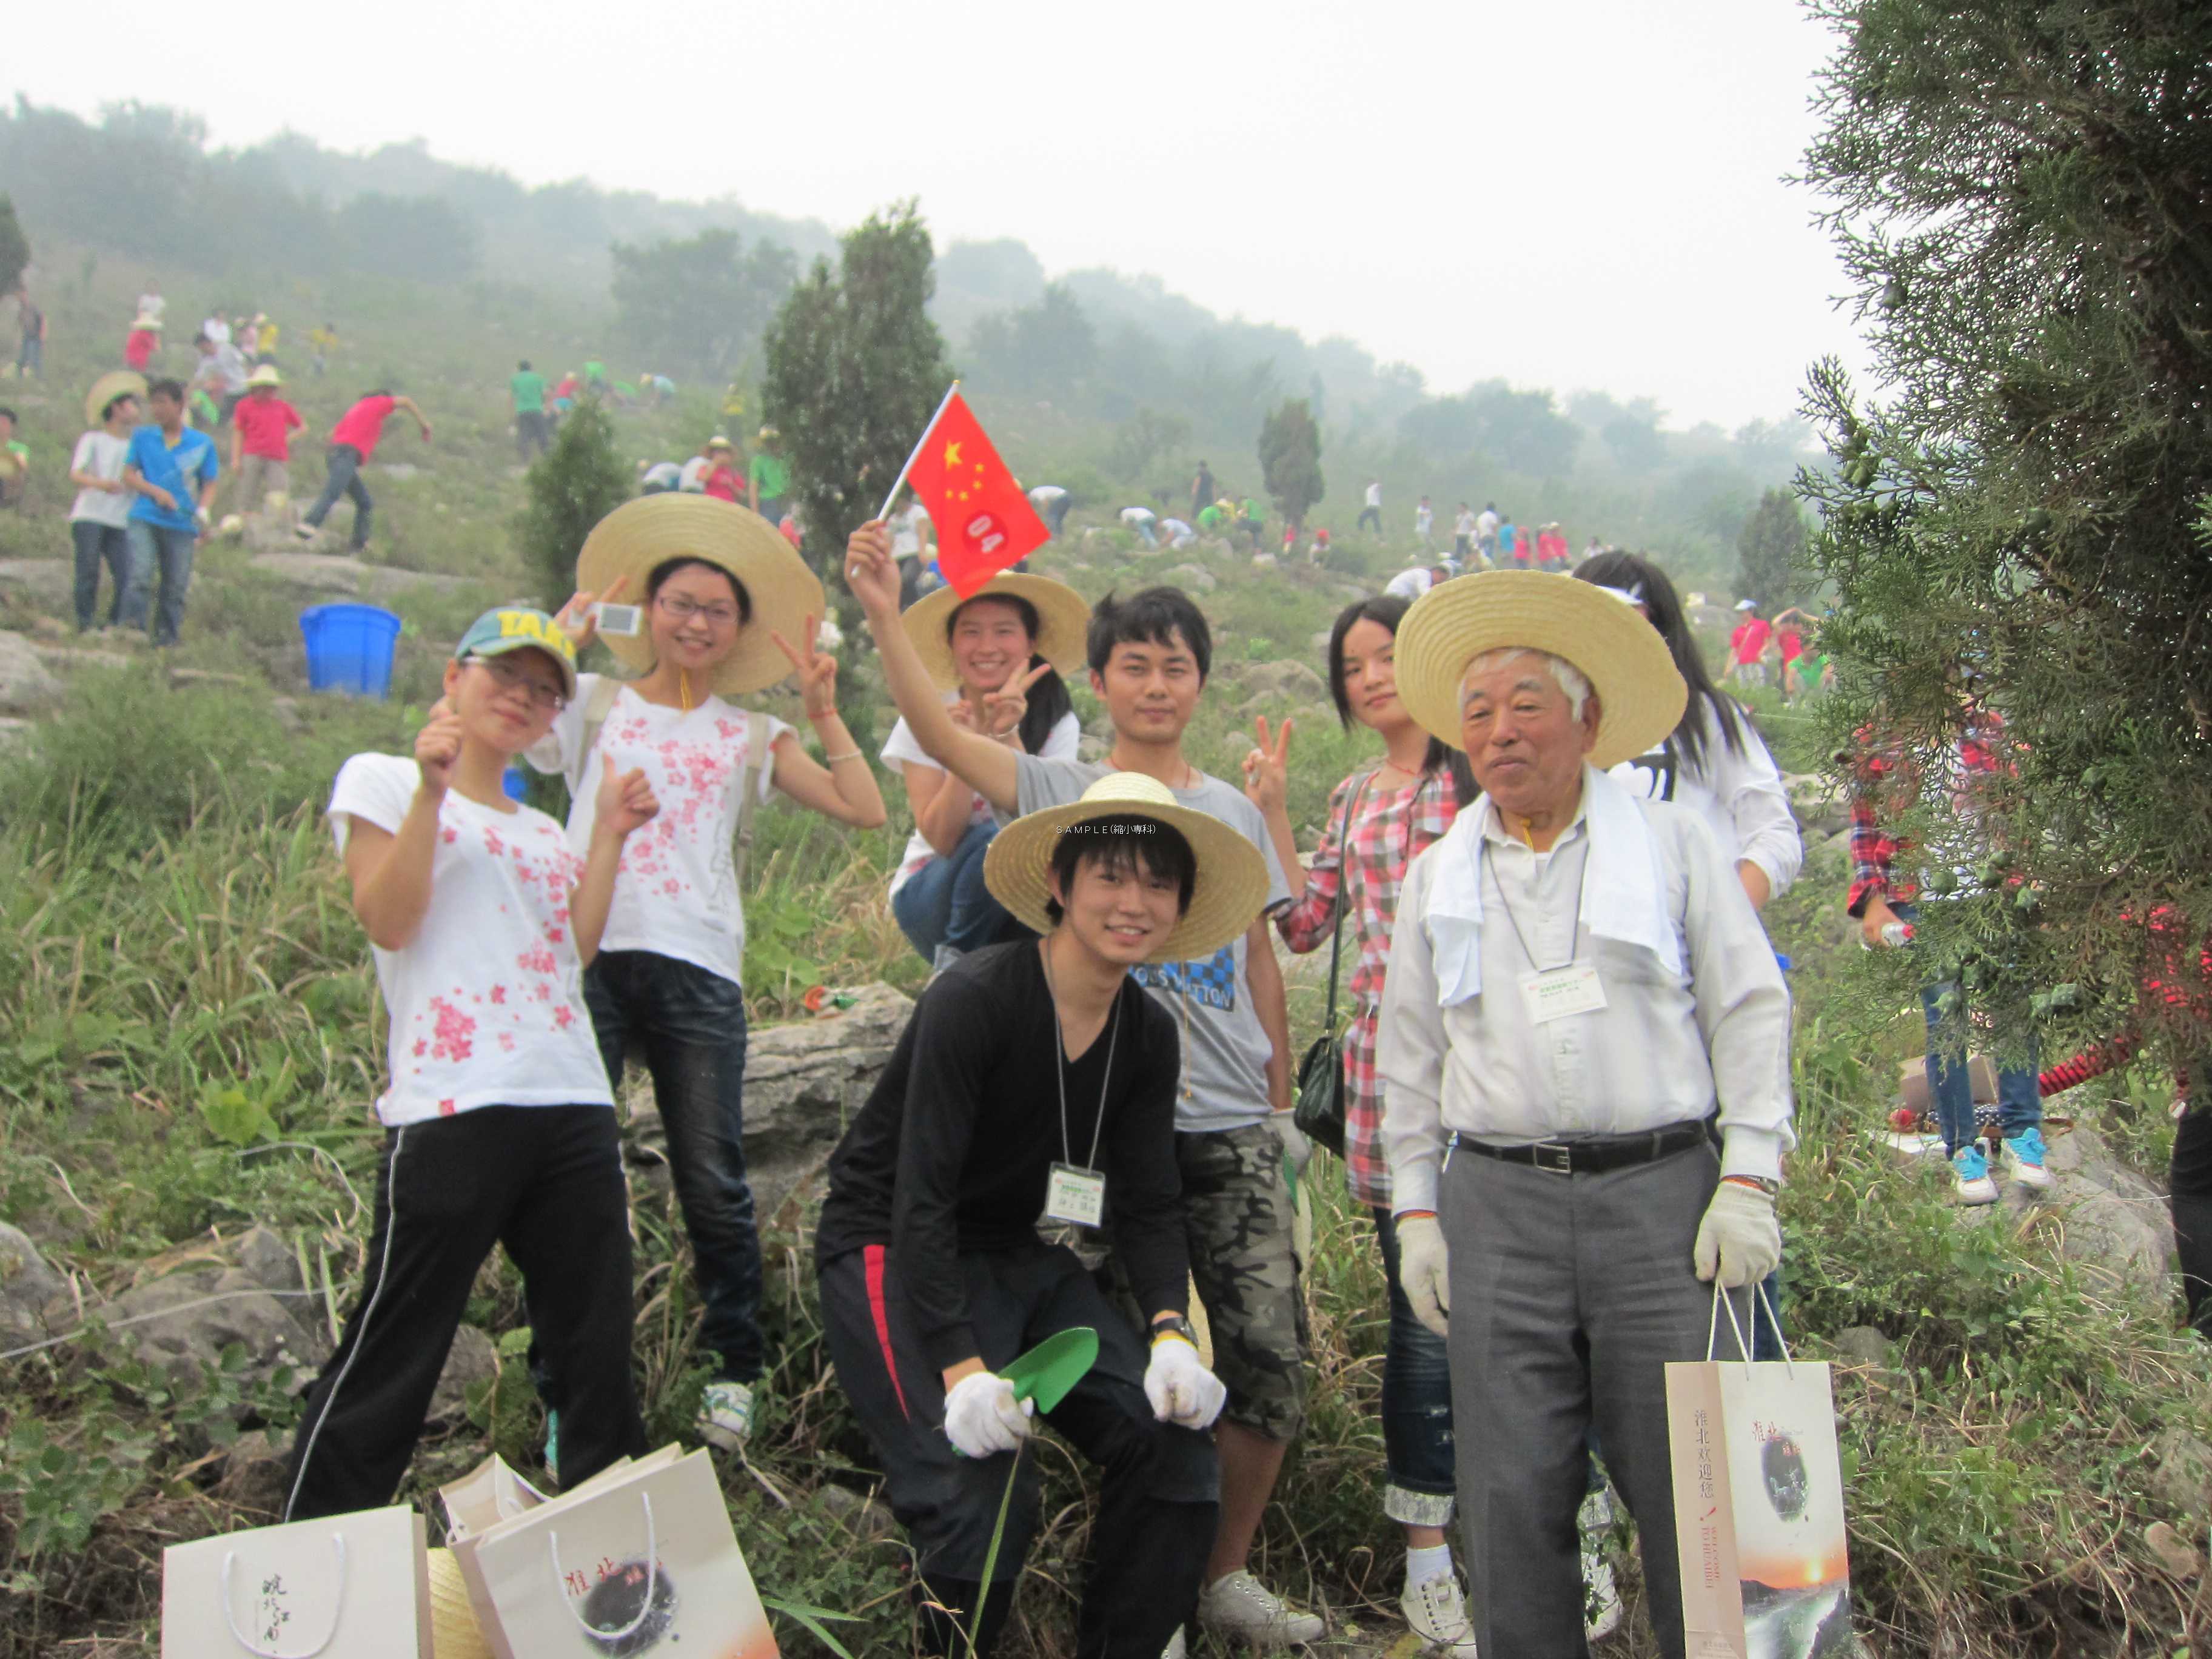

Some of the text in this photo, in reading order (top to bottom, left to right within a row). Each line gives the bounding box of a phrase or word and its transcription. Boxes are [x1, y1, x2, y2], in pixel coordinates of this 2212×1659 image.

[1694, 1409, 1714, 1498] 淮北欢迎您
